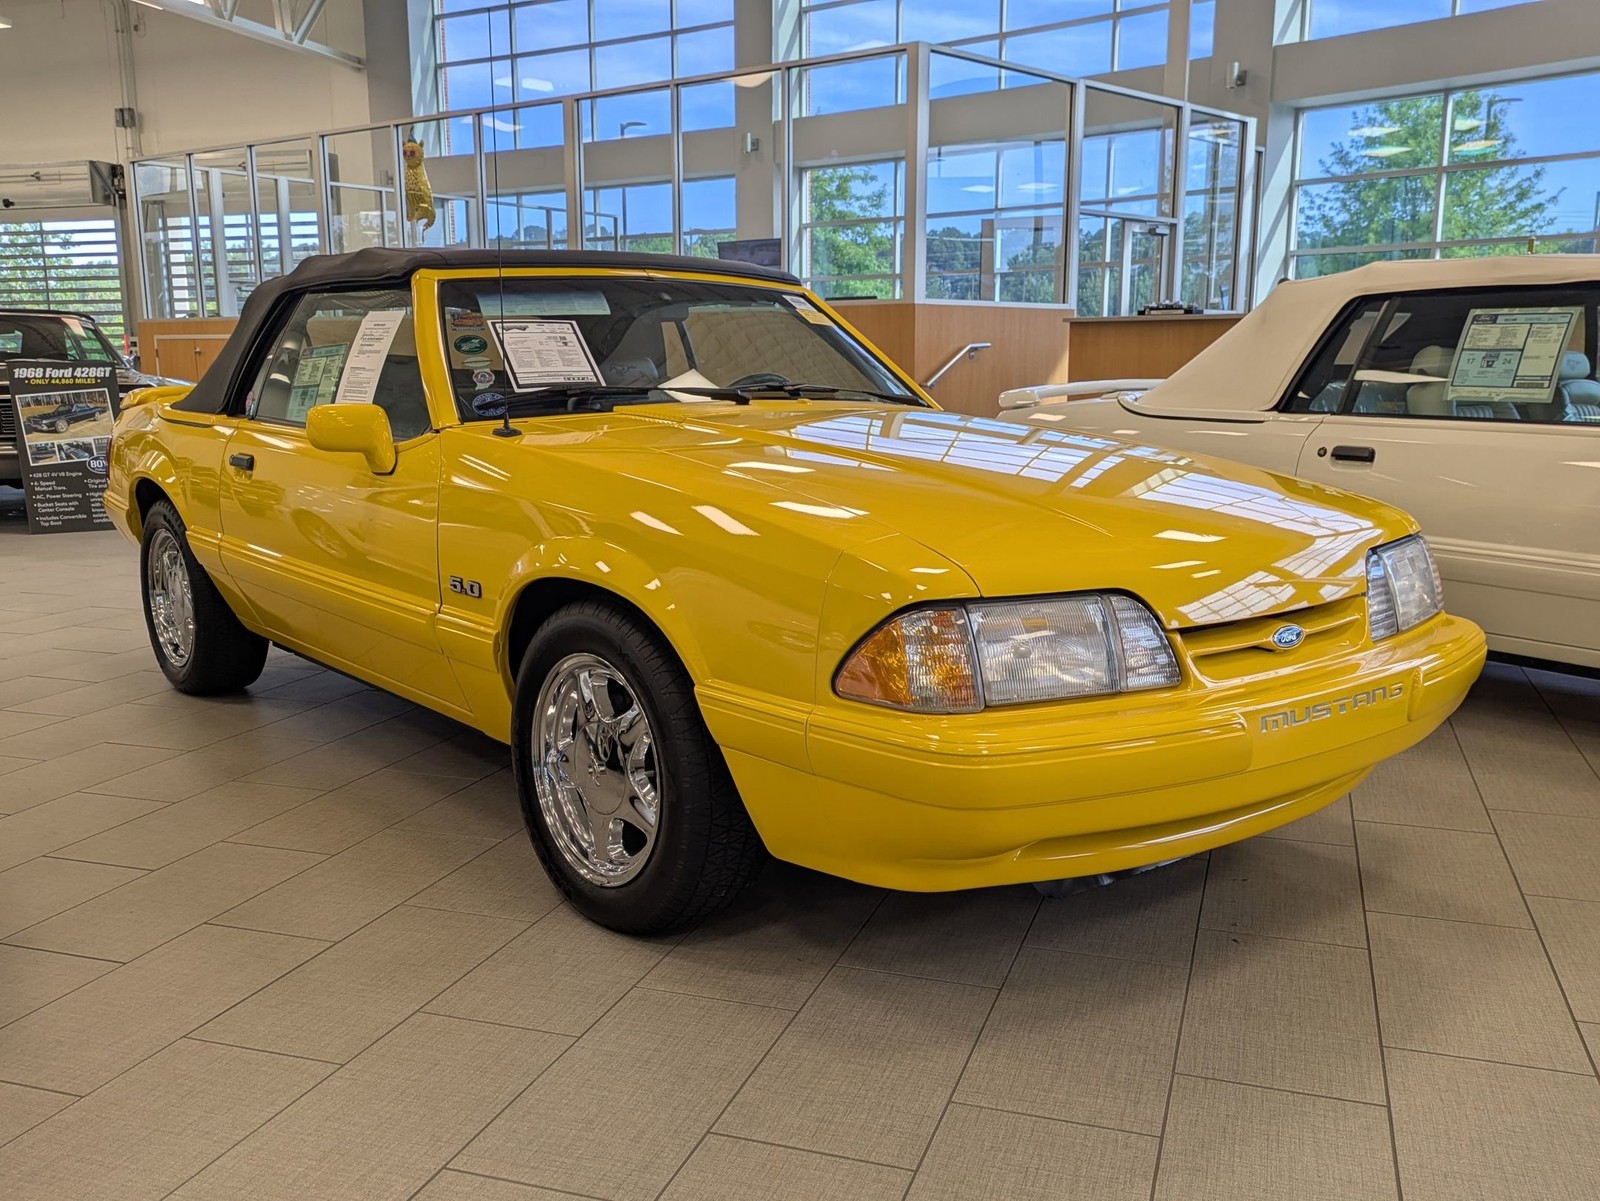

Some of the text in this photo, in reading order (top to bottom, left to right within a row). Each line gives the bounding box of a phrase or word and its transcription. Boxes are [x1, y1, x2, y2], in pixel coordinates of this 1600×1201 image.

[13, 367, 112, 379] 1968 Ford 428GT
[449, 575, 482, 599] 5.0
[1275, 627, 1301, 644] Ford
[1260, 683, 1404, 733] MUSTANG
